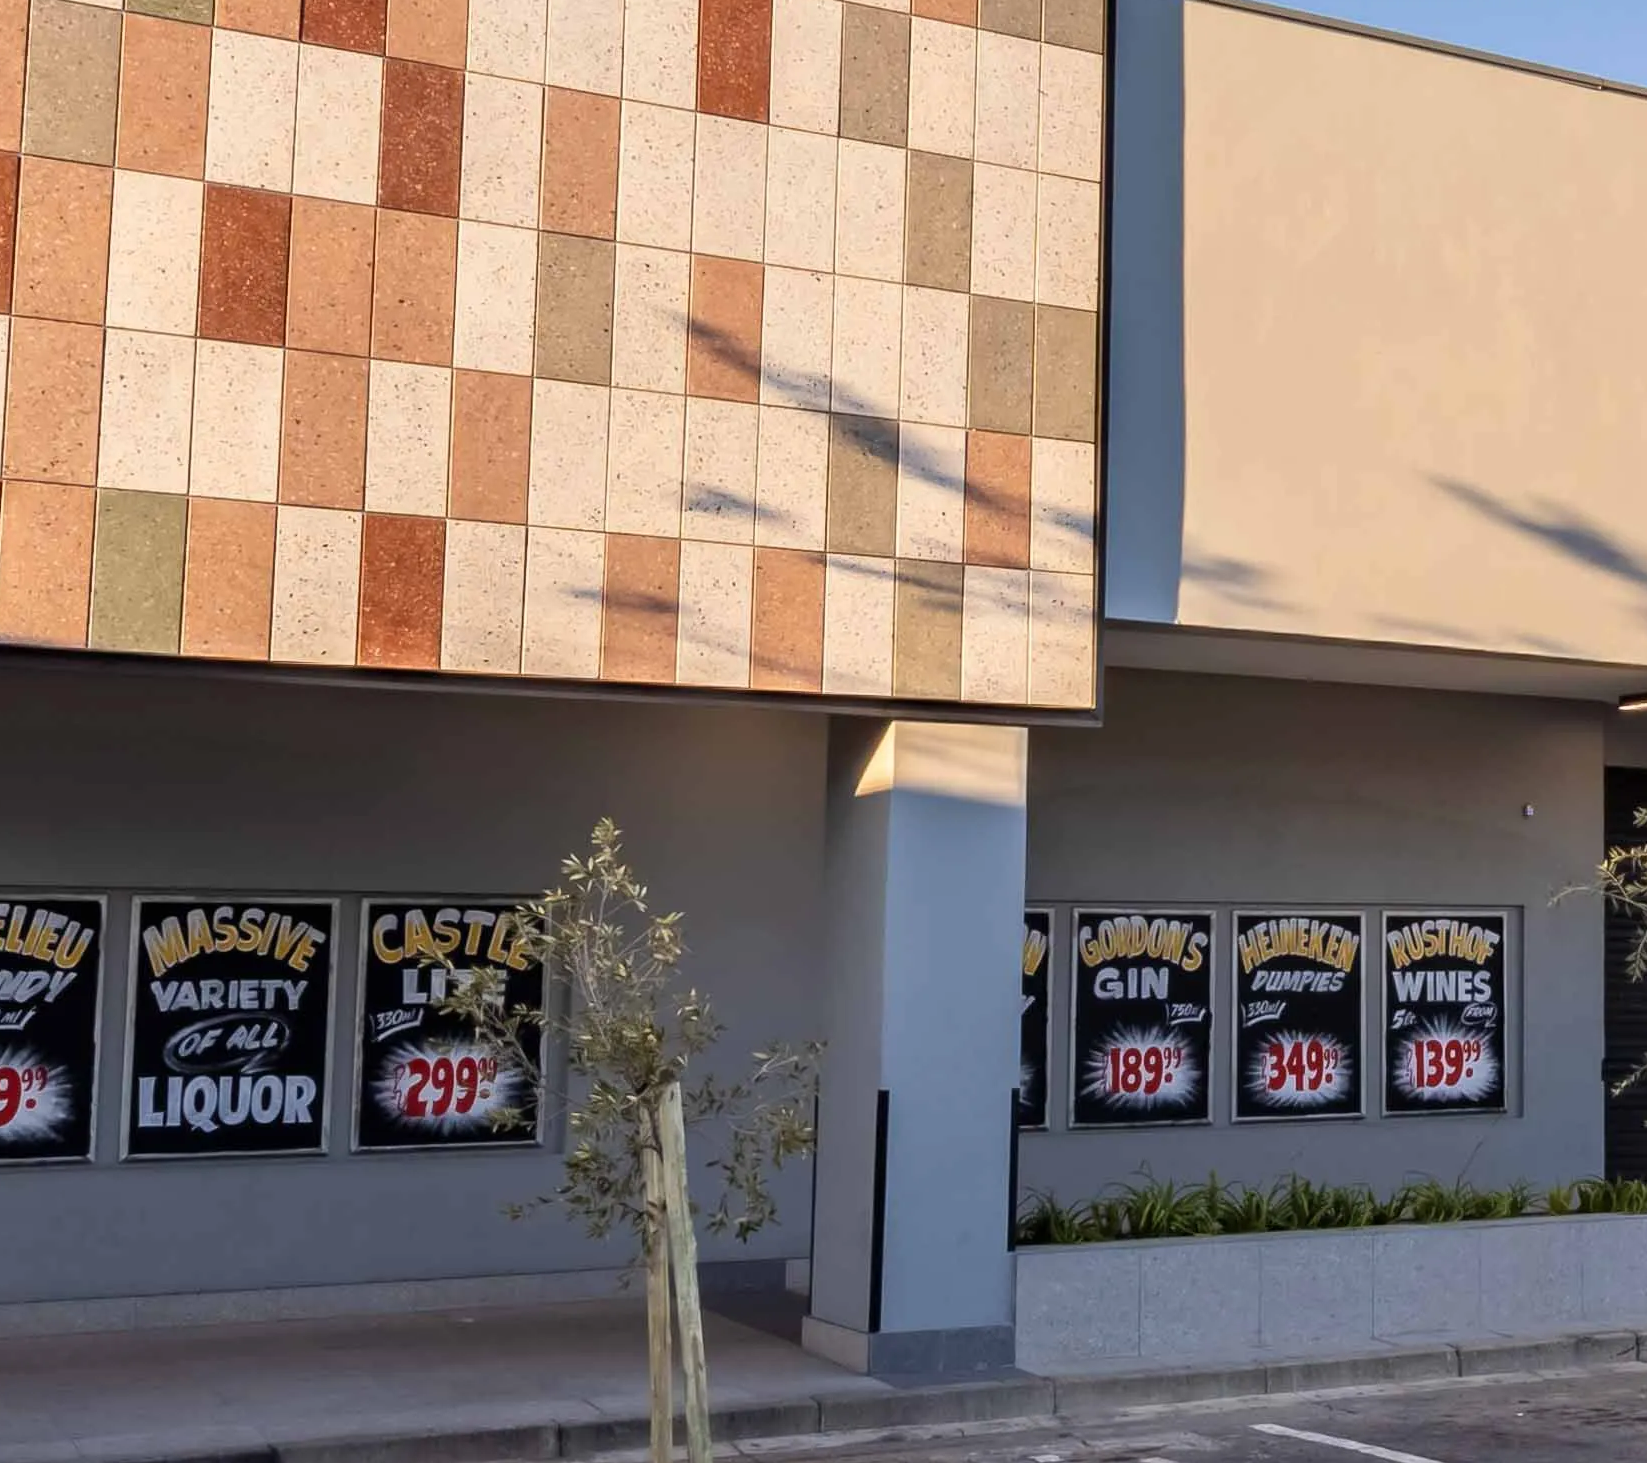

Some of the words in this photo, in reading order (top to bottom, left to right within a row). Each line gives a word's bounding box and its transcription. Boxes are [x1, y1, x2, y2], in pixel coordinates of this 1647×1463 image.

[143, 906, 326, 978] MASSIVE
[372, 908, 529, 972] CASTLE
[1079, 915, 1208, 972] GORDON'S
[1238, 918, 1359, 974] HEINEKEN
[1387, 919, 1500, 969] RUSTHOF
[150, 979, 308, 1013] VARIETY
[1093, 966, 1170, 1000] GIN
[1251, 970, 1346, 992] DUMPIES
[1392, 970, 1492, 1003] WINES
[178, 1028, 223, 1057] OF
[226, 1022, 279, 1050] ALL
[138, 1075, 317, 1133] LIQUOR
